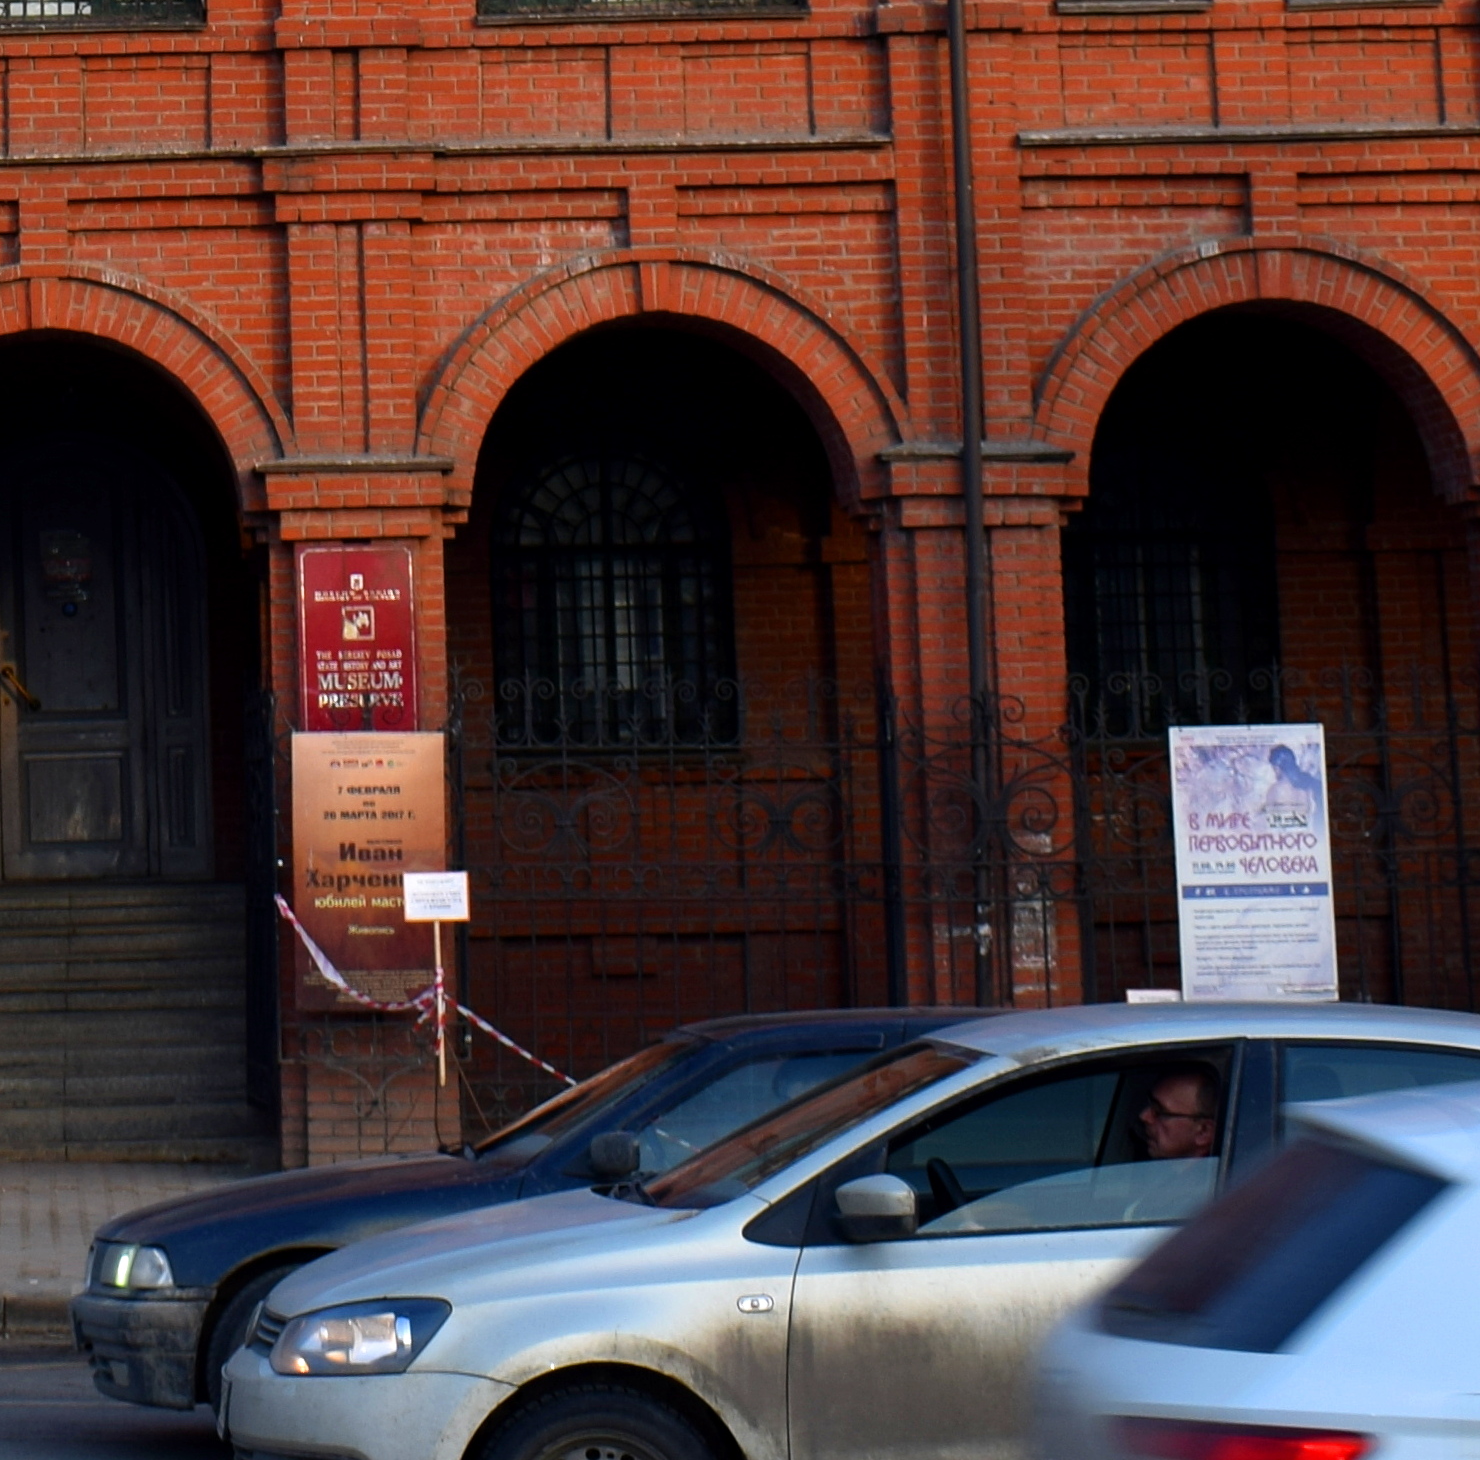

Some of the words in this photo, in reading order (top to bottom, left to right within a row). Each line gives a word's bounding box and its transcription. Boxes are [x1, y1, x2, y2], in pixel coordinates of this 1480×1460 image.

[340, 811, 377, 820] МАРТА
[339, 842, 403, 862] Иван
[314, 893, 367, 908] юбилей
